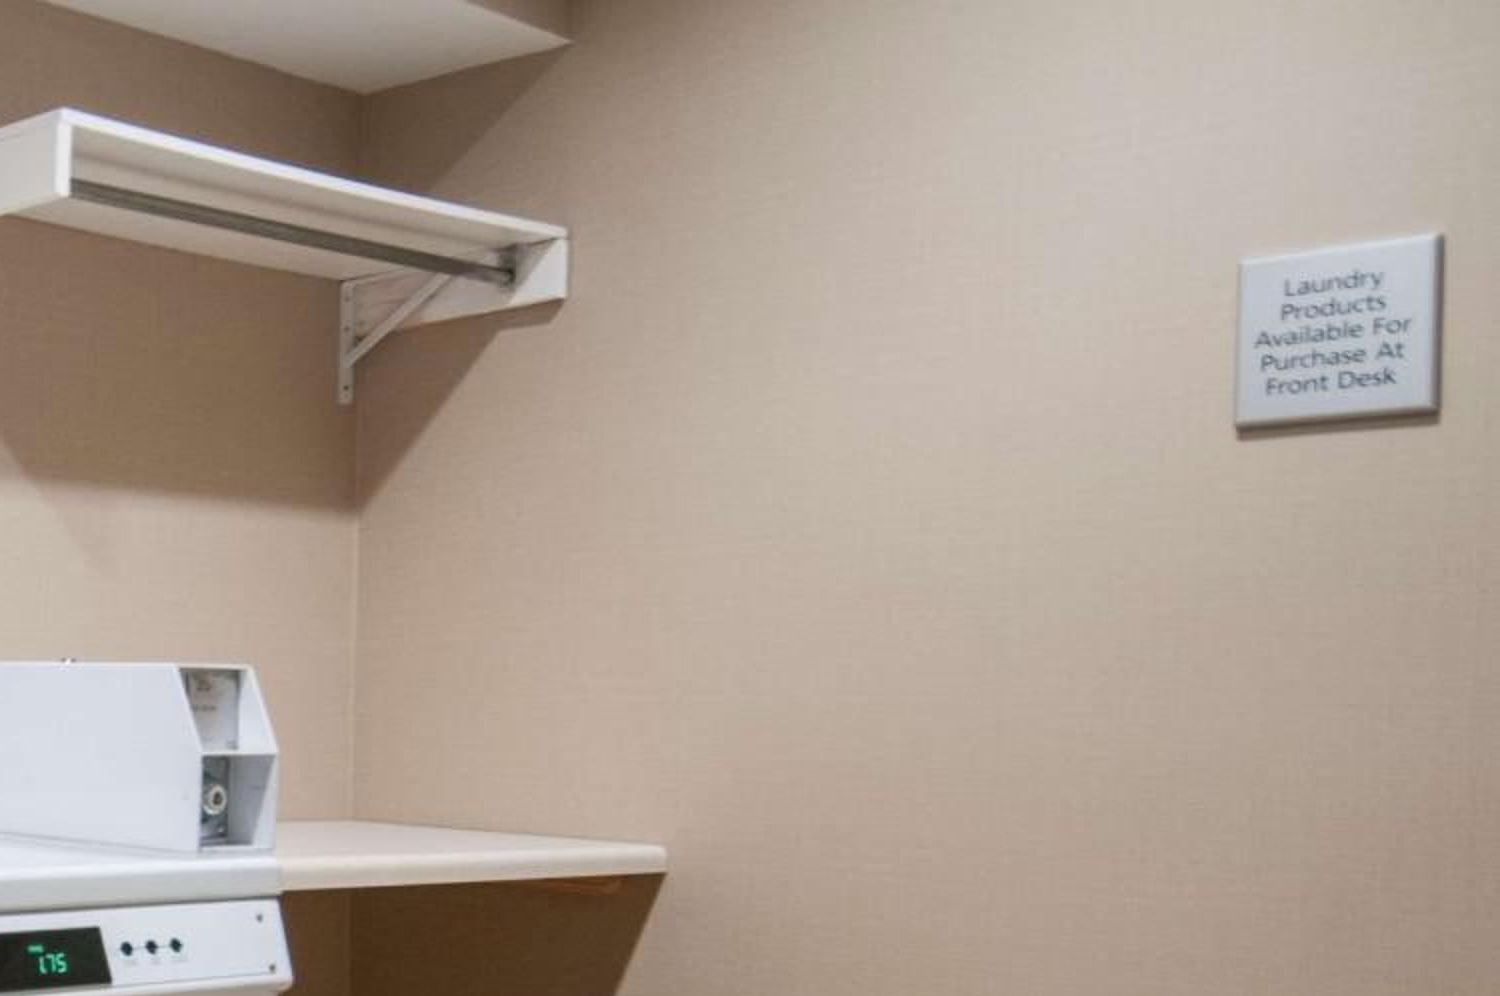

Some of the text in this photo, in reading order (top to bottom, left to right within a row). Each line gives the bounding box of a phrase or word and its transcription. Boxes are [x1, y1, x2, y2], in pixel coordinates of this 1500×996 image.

[1284, 271, 1383, 297] Laundry
[1280, 296, 1387, 321] Products
[1254, 317, 1412, 348] Available For
[1260, 341, 1405, 372] Purchase At
[1266, 367, 1397, 396] Front Desk
